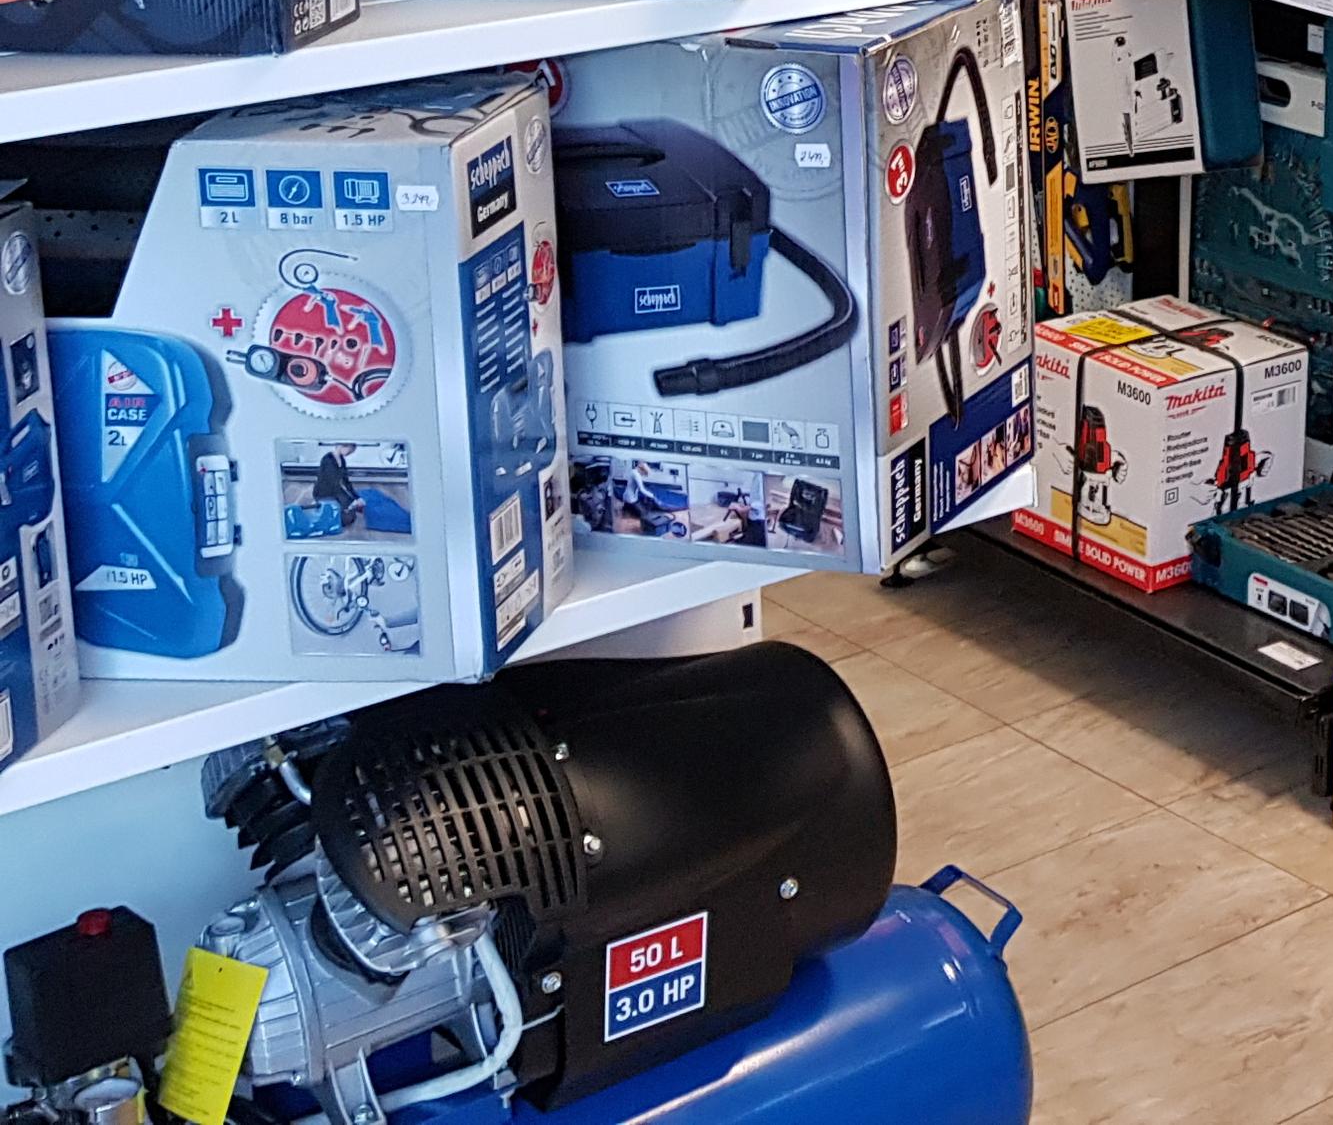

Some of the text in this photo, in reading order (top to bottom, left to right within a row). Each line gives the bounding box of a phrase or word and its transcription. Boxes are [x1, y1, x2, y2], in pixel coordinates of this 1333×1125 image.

[768, 85, 821, 112] INNOVATION
[1027, 76, 1040, 152] IRWIN
[470, 137, 511, 191] scheppach
[220, 212, 239, 223] 2 L
[280, 212, 313, 225] 8 bar
[343, 214, 386, 227] 1.5 HP
[477, 192, 509, 223] Germany
[1265, 360, 1301, 380] M3600
[1117, 381, 1150, 405] M3600
[1166, 384, 1226, 411] makita
[107, 408, 147, 422] CASE
[108, 431, 126, 447] 2L
[892, 459, 909, 542] scheppach
[913, 459, 923, 522] Germany
[1086, 542, 1111, 566] SOLID
[1113, 555, 1146, 582] POWER
[131, 570, 147, 585] HP
[629, 940, 684, 972] 50 L
[615, 976, 696, 1023] 3.0 HP
